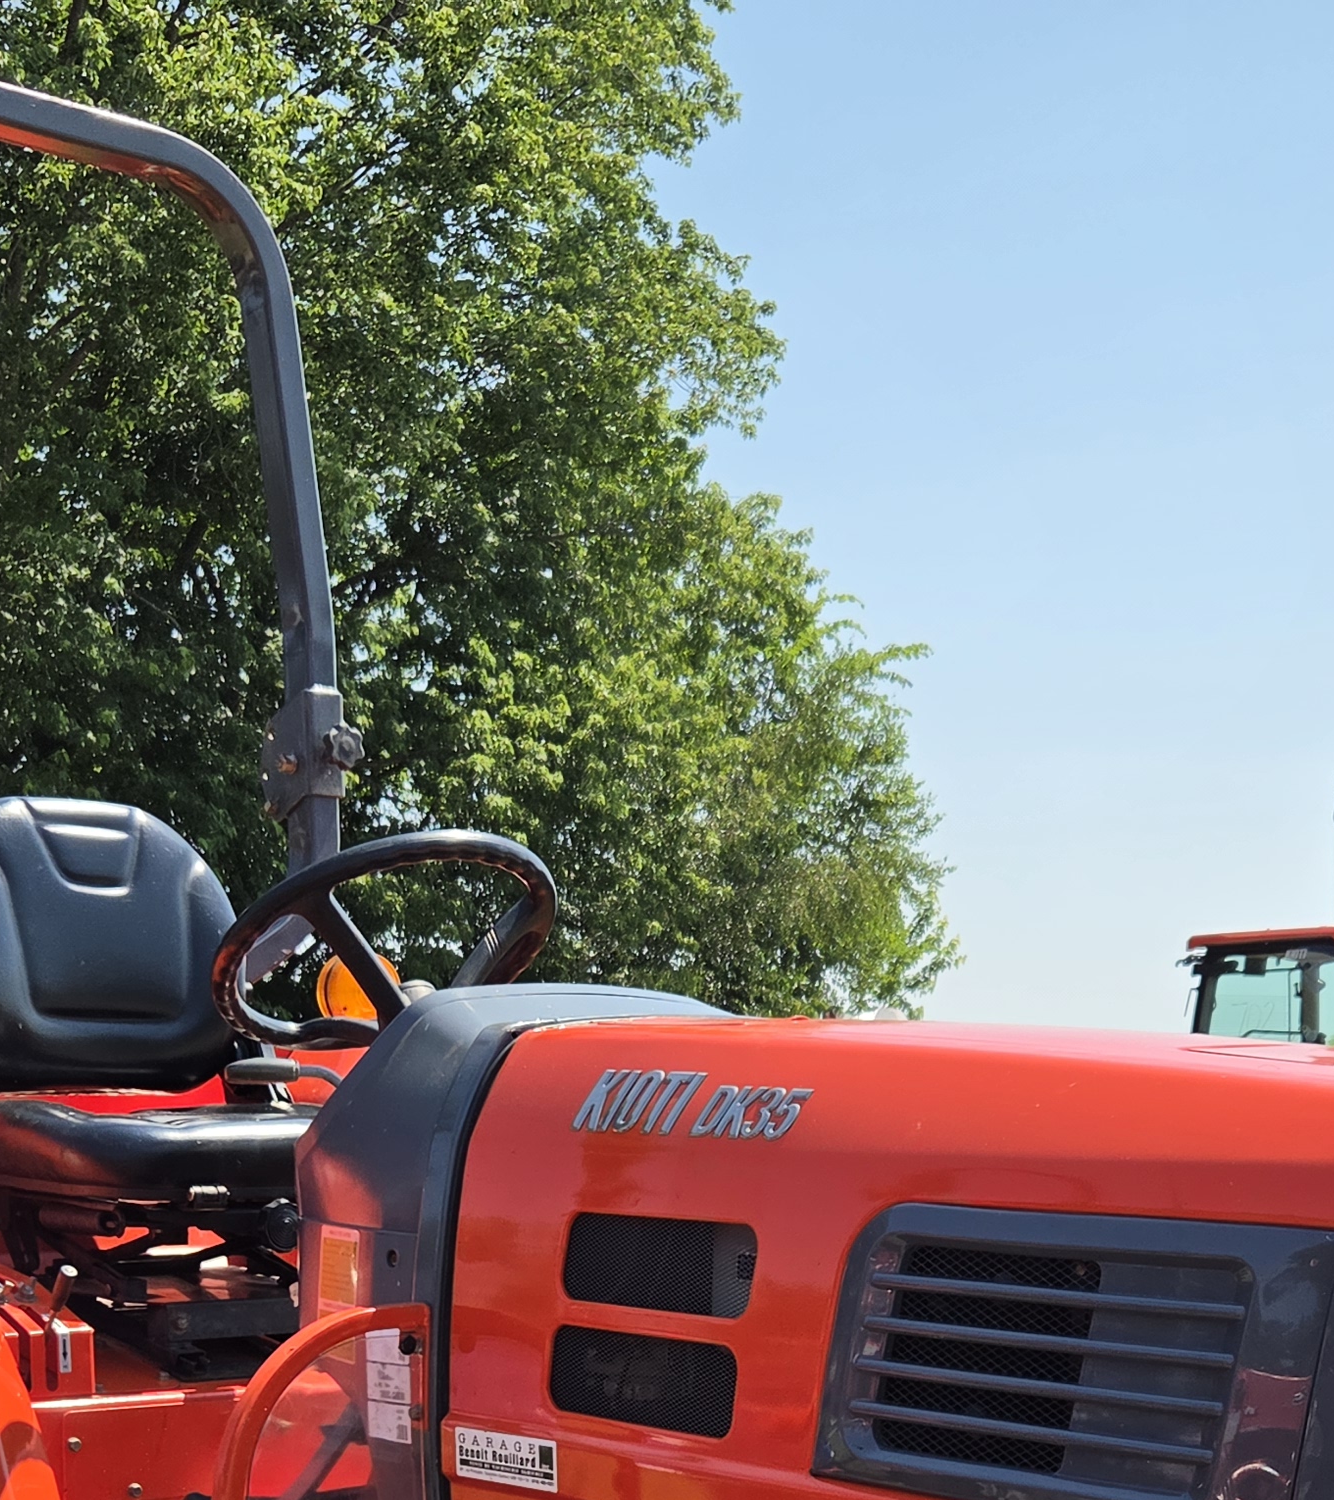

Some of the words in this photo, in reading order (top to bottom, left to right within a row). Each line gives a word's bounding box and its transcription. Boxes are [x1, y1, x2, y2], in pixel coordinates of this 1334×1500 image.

[569, 1068, 709, 1135] KIOTI
[688, 1084, 815, 1140] DK35
[458, 1432, 537, 1455] GARAGE
[491, 1450, 537, 1468] Rouillard
